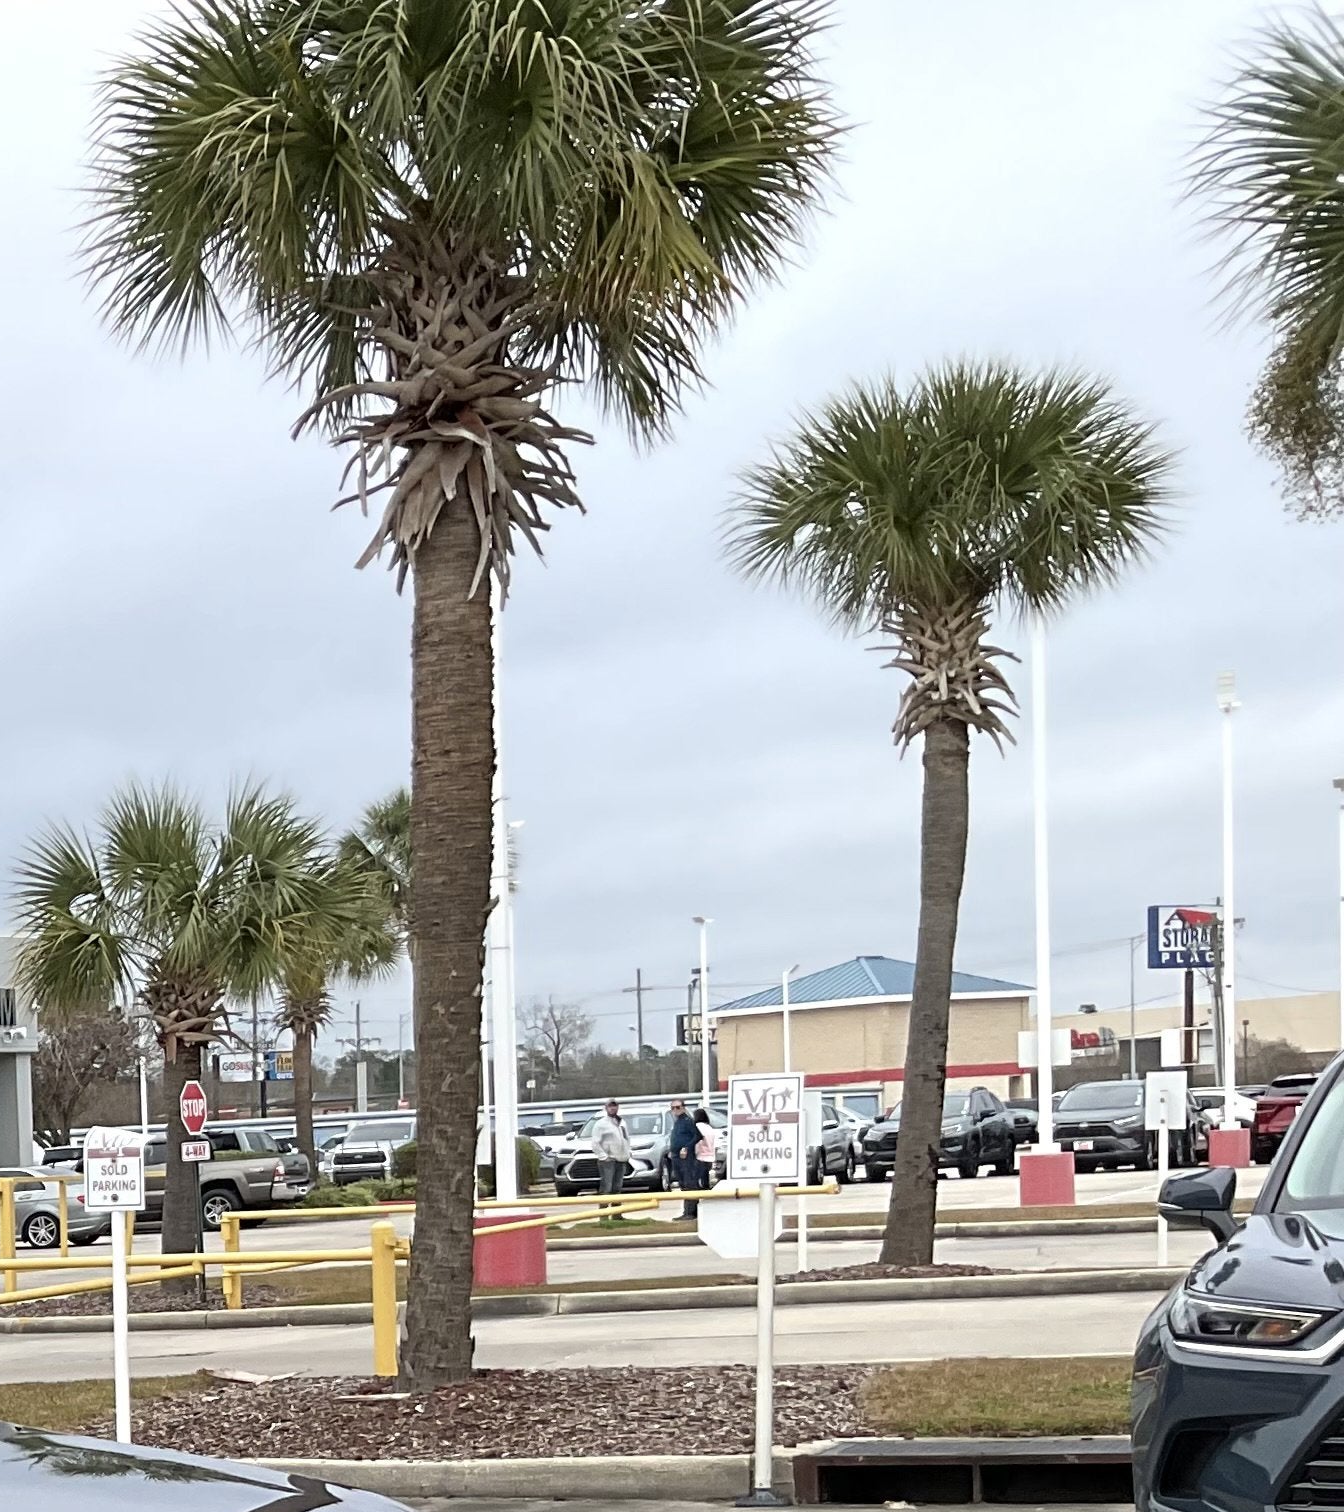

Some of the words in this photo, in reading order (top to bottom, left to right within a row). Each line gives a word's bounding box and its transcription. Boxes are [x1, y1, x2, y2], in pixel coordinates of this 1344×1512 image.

[1161, 951, 1224, 964] PLAC
[183, 1099, 204, 1118] STOP
[748, 1130, 782, 1142] SOLD
[185, 1144, 206, 1157] 4-WAY
[737, 1147, 792, 1160] PARKING
[101, 1164, 128, 1175] SOLD
[92, 1180, 137, 1191] PARKING
